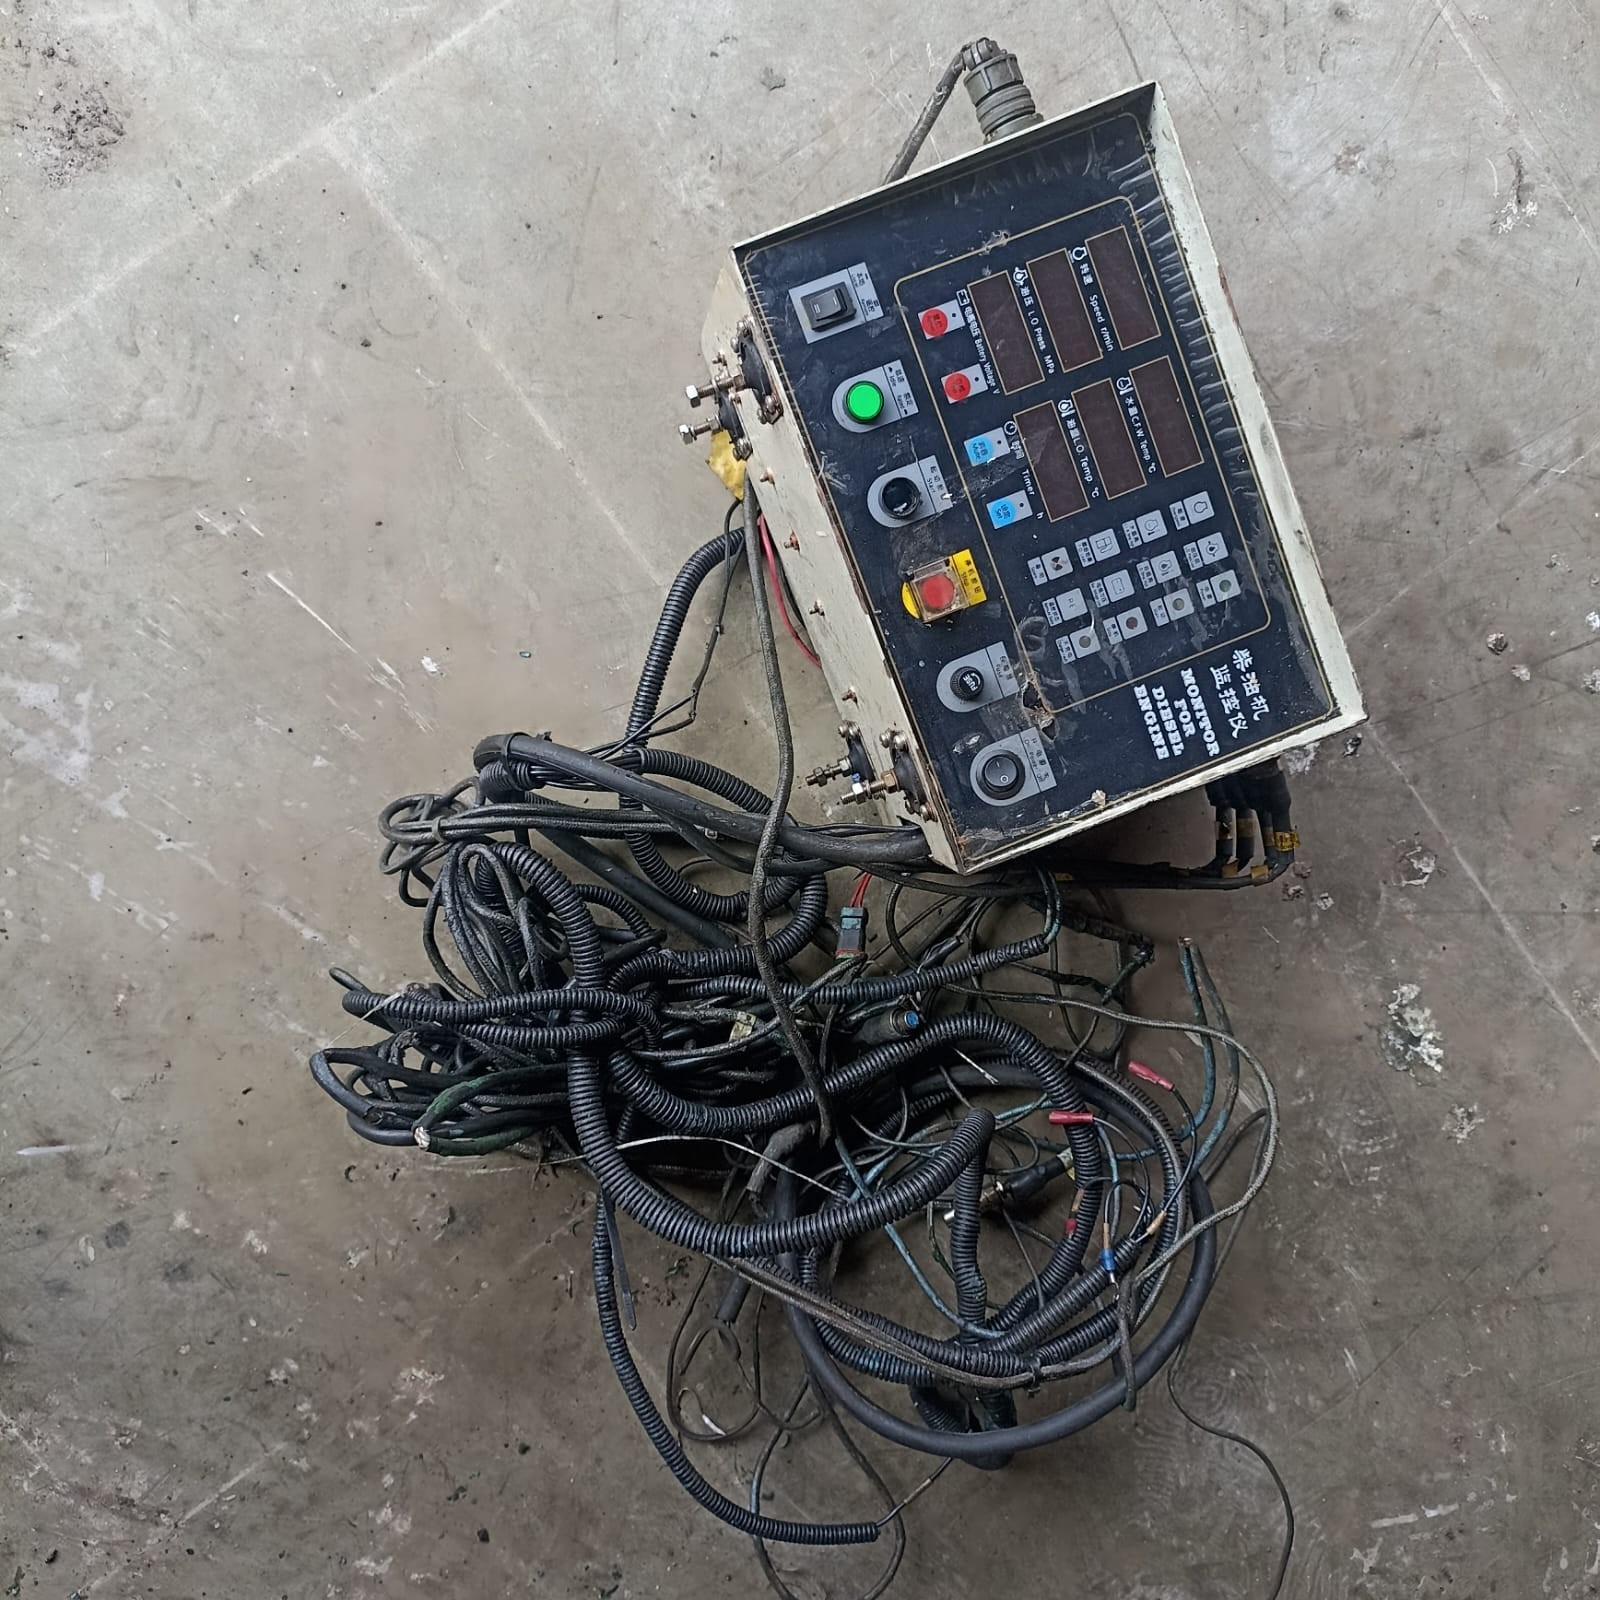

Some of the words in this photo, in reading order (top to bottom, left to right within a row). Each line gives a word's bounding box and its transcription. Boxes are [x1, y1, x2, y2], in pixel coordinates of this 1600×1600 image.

[1020, 286, 1034, 306] 油压
[1044, 355, 1055, 374] MPa
[1090, 294, 1105, 323] Speed
[1101, 327, 1113, 351] r/min
[975, 338, 986, 362] Battery
[984, 362, 996, 386] Voltage
[992, 387, 1001, 396] V
[926, 477, 937, 494] Start
[1021, 469, 1036, 497] Timer
[1036, 511, 1045, 520] h
[963, 674, 978, 692] FUSE
[1181, 668, 1220, 757] MONITOR
[1210, 664, 1248, 738] 监控仪
[1232, 648, 1269, 721] 柴油机
[1134, 684, 1169, 760] ENGINE
[1152, 686, 1184, 756] DIESEL
[1174, 698, 1196, 737] FOR
